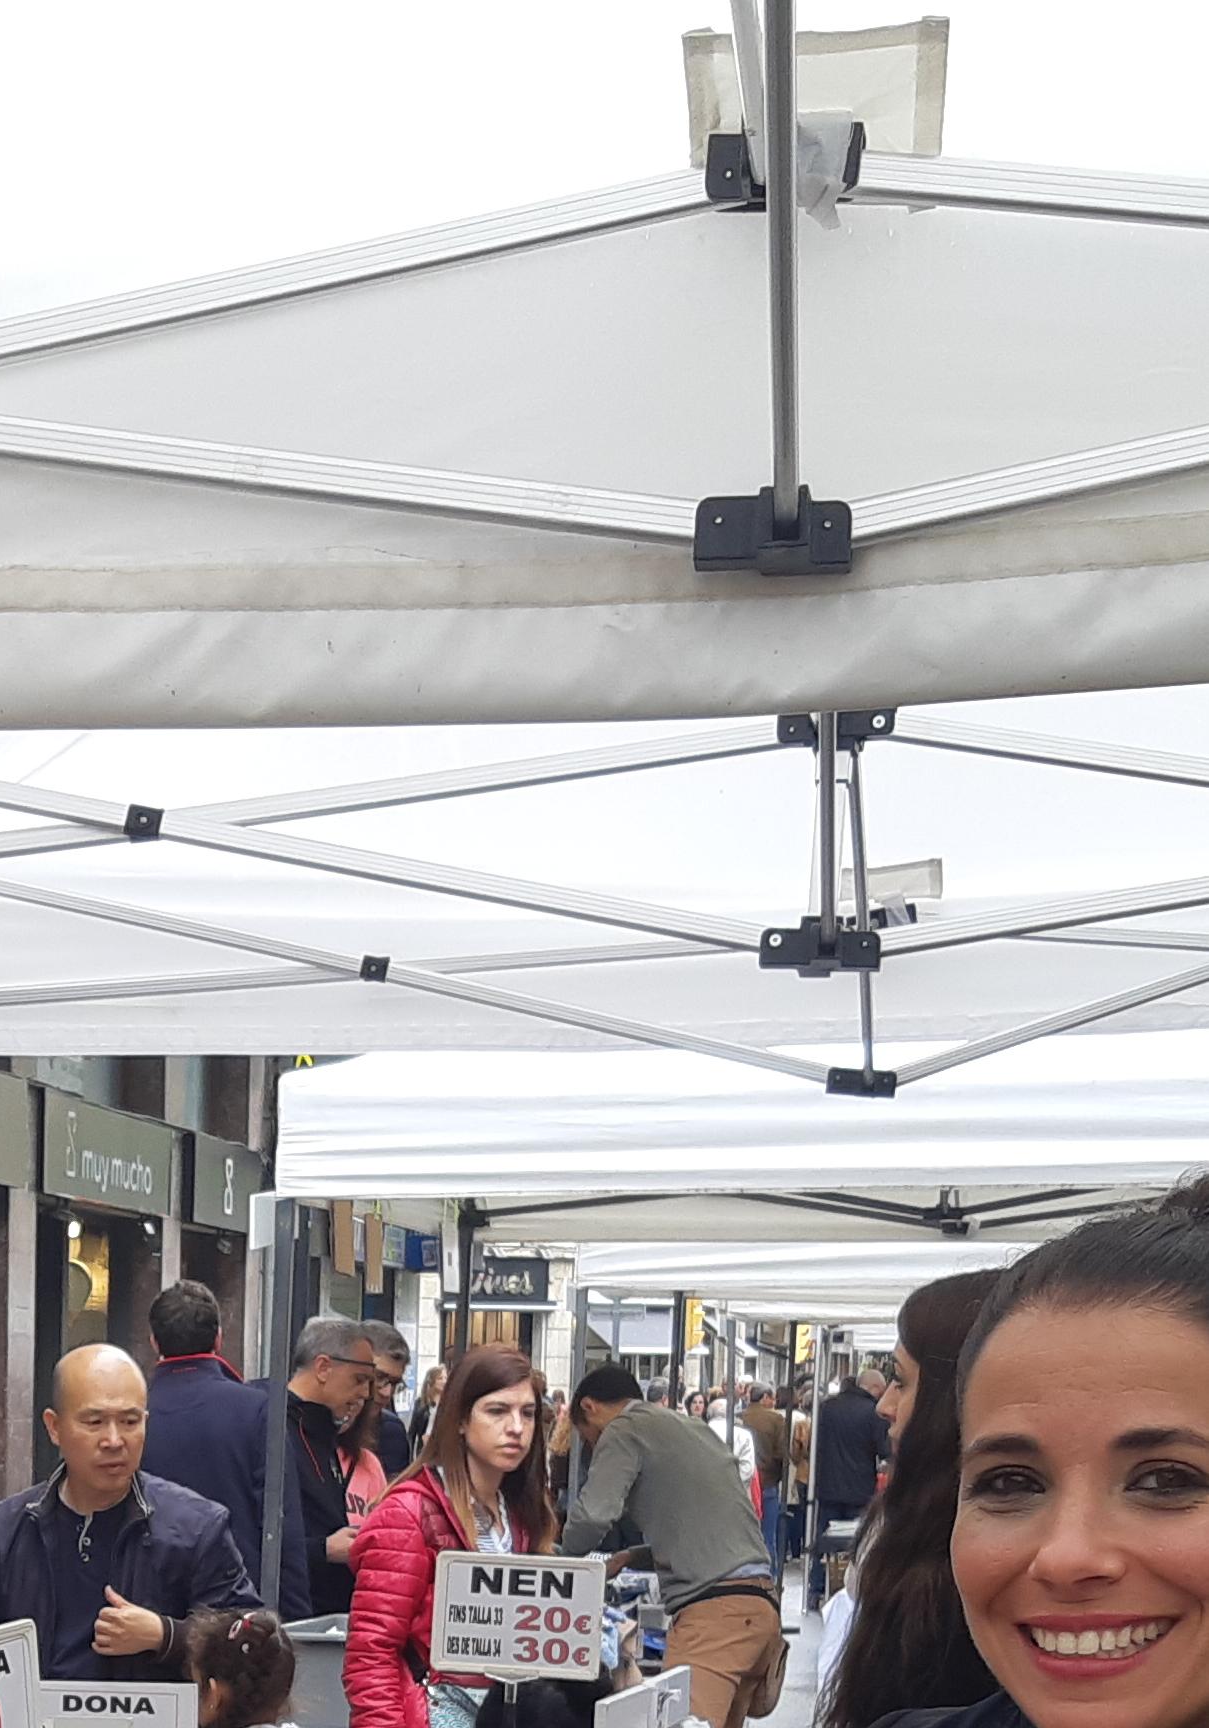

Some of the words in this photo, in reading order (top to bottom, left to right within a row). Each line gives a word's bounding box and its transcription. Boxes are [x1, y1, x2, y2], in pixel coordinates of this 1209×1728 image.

[470, 1566, 574, 1600] NEN
[448, 1603, 467, 1625] FINS
[468, 1605, 492, 1625] TALLA
[493, 1607, 504, 1626] 33
[513, 1604, 592, 1635] 20€
[446, 1635, 460, 1655] DES
[460, 1636, 471, 1656] DE
[471, 1637, 491, 1657] TALLA
[492, 1638, 502, 1658] 34
[512, 1636, 591, 1667] 30€
[62, 1694, 156, 1715] DONA
